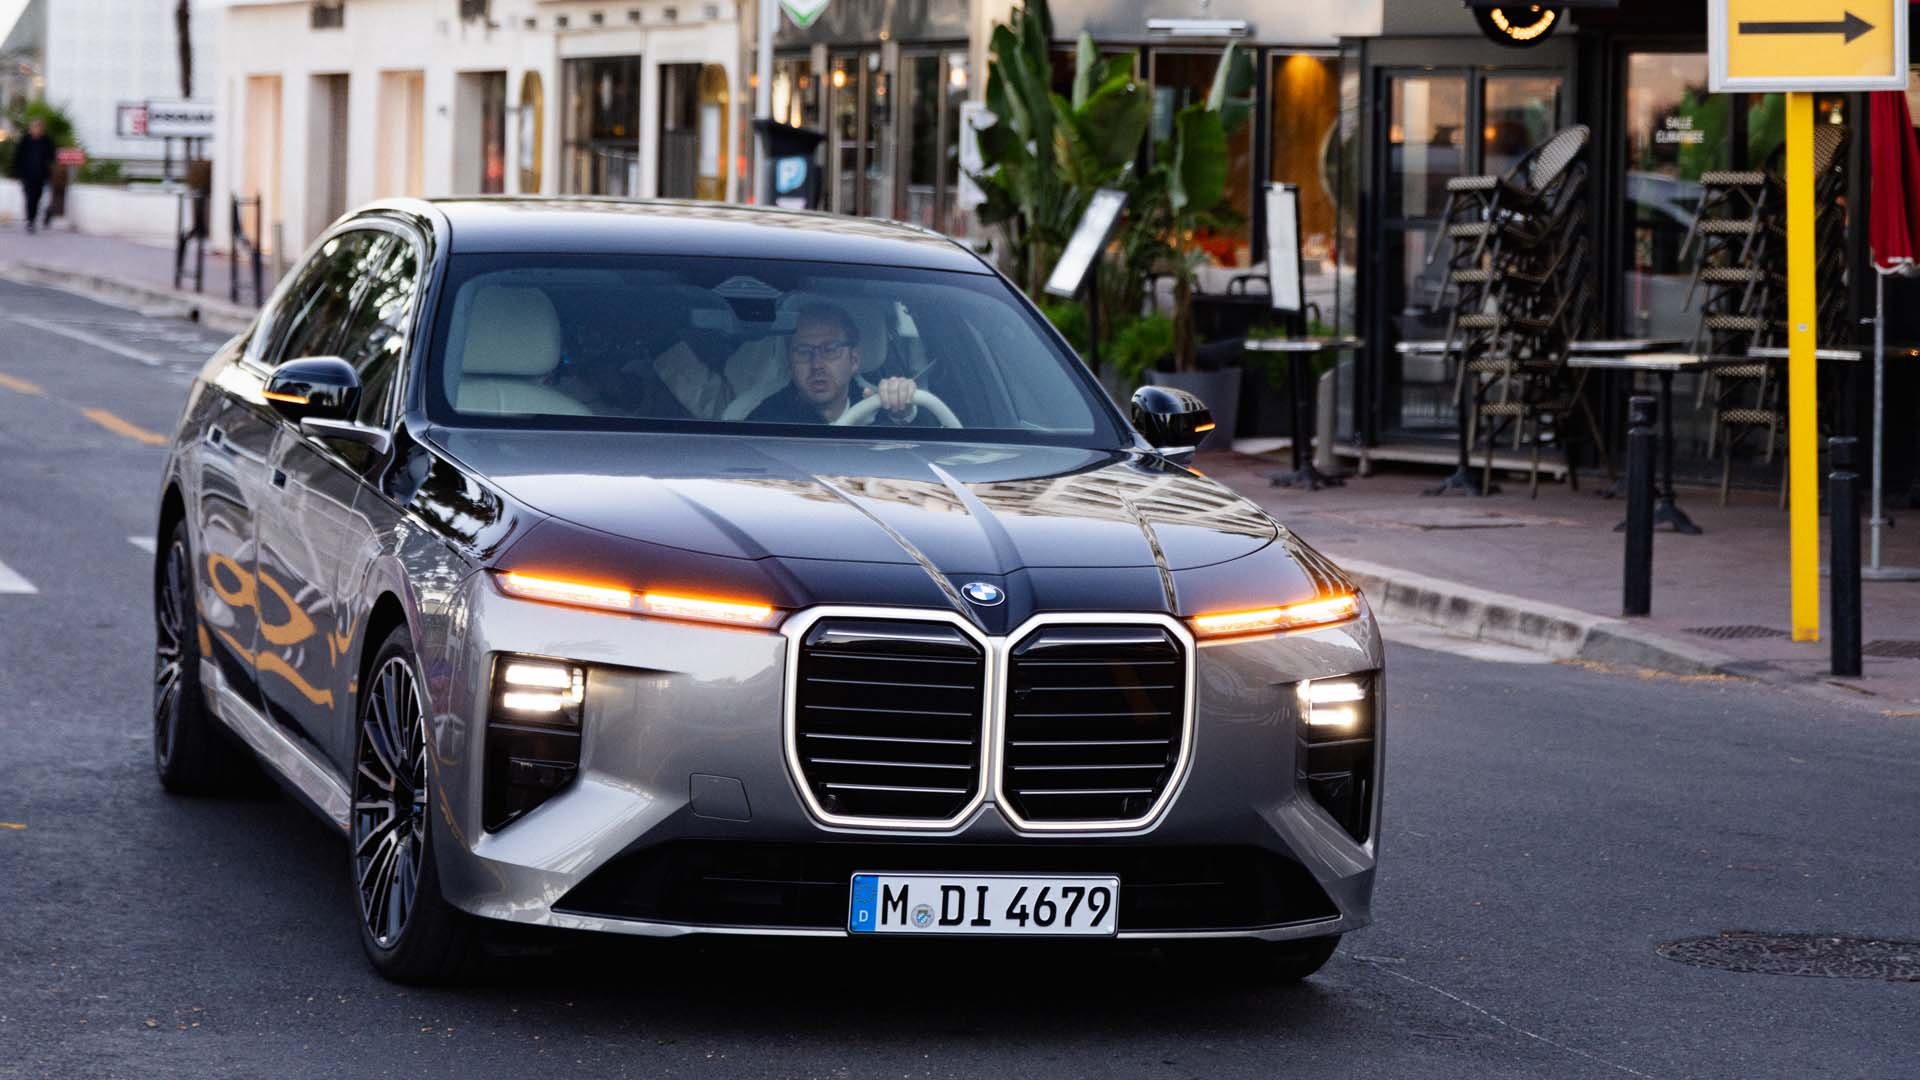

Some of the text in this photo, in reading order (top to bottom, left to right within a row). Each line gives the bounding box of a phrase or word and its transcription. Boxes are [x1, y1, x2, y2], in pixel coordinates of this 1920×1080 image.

[1666, 116, 1694, 130] SALLE
[880, 884, 1112, 928] M DI 4679
[858, 910, 869, 923] D
